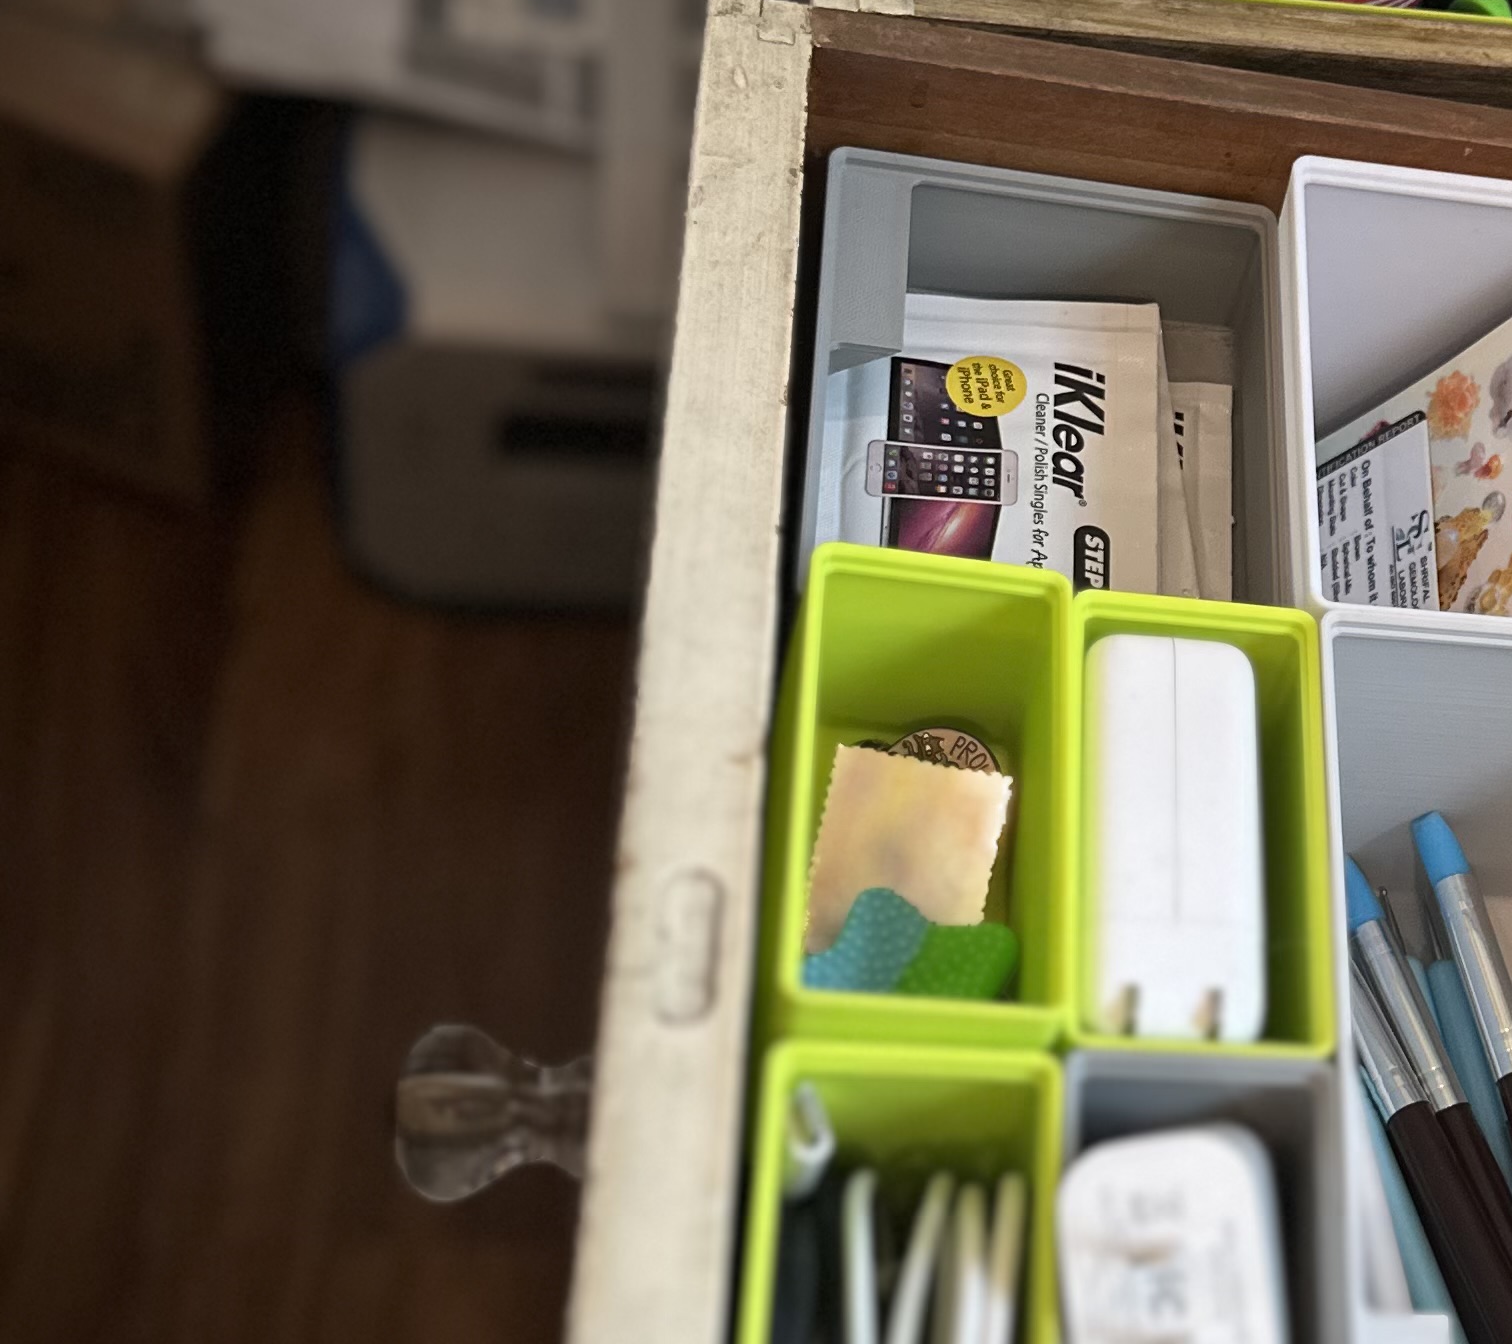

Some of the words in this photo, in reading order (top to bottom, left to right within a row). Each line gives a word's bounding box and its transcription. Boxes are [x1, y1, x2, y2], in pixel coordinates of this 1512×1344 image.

[956, 365, 975, 405] iPhone
[975, 376, 994, 402] iPad
[994, 390, 1007, 404] for
[1001, 368, 1017, 393] Great
[1034, 392, 1050, 438] Cleaner
[1053, 361, 1107, 499] iKlear
[1033, 447, 1049, 483] Polish
[1361, 459, 1371, 479] On
[1030, 484, 1049, 526] Singles
[1362, 477, 1374, 516] Behalf
[1032, 527, 1050, 548] for
[1365, 536, 1377, 554] To
[1084, 533, 1105, 589] STEP
[1367, 554, 1378, 593] whom
